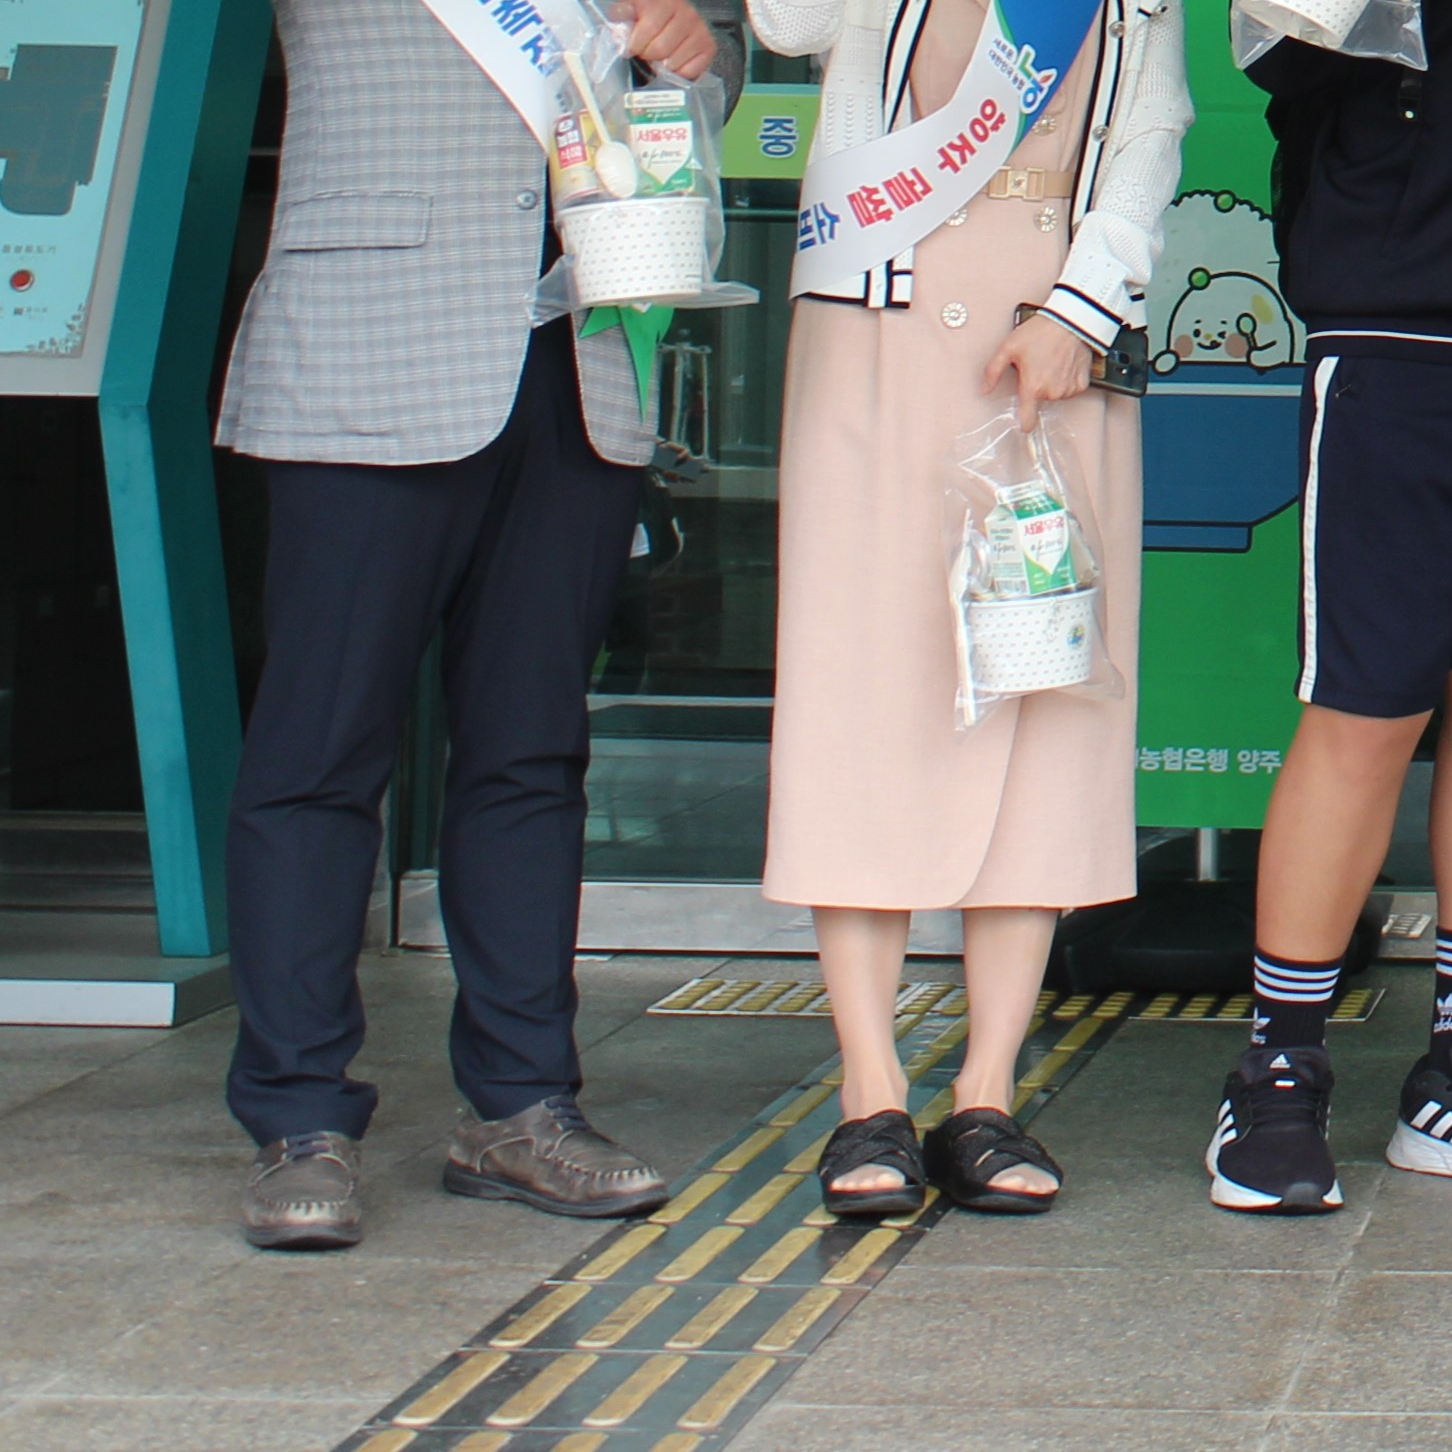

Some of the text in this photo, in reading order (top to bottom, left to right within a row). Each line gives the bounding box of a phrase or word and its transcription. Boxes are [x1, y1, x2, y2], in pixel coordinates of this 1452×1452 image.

[637, 127, 689, 143] 서울우유
[759, 118, 797, 157] 중
[936, 98, 1007, 175] 양주
[846, 166, 934, 229] 골쌀
[1023, 515, 1065, 536] 서울우유
